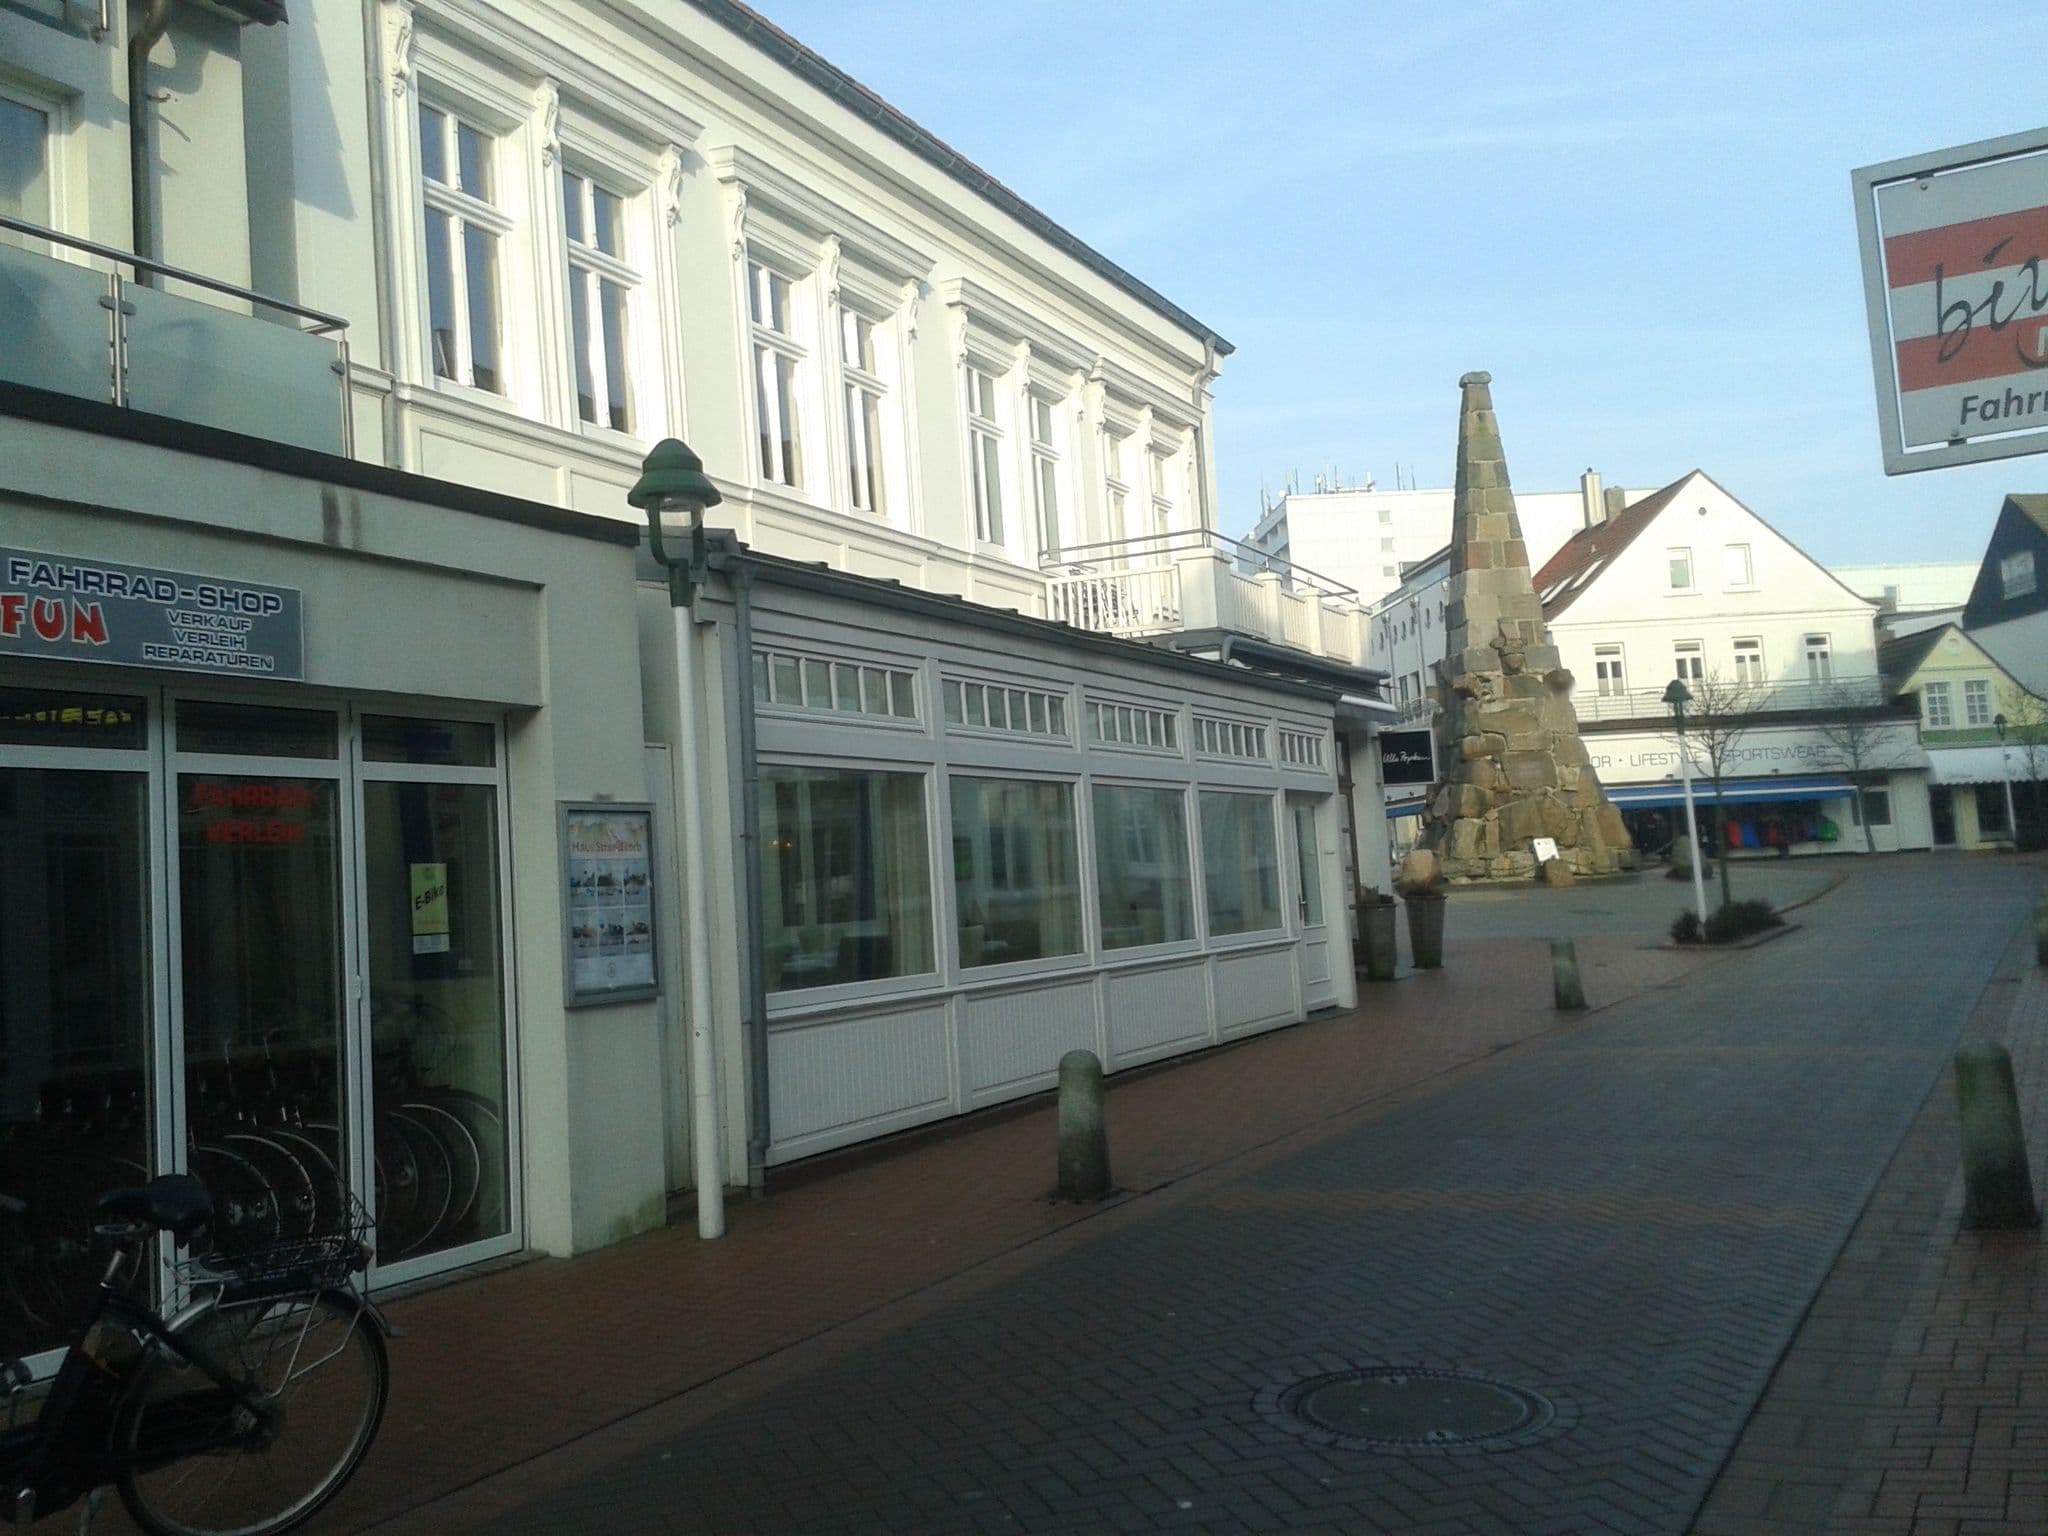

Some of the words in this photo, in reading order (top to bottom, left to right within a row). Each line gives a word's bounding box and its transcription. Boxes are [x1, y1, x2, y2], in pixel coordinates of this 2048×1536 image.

[9, 557, 283, 616] FAHRRAD-SHOP
[0, 592, 110, 647] FUN
[166, 608, 253, 633] VERKAUF
[173, 628, 248, 650] VERLEIH
[142, 642, 276, 671] REPARATUREN
[1589, 754, 1612, 769] OR
[1629, 750, 1704, 768] LIFESTYLE
